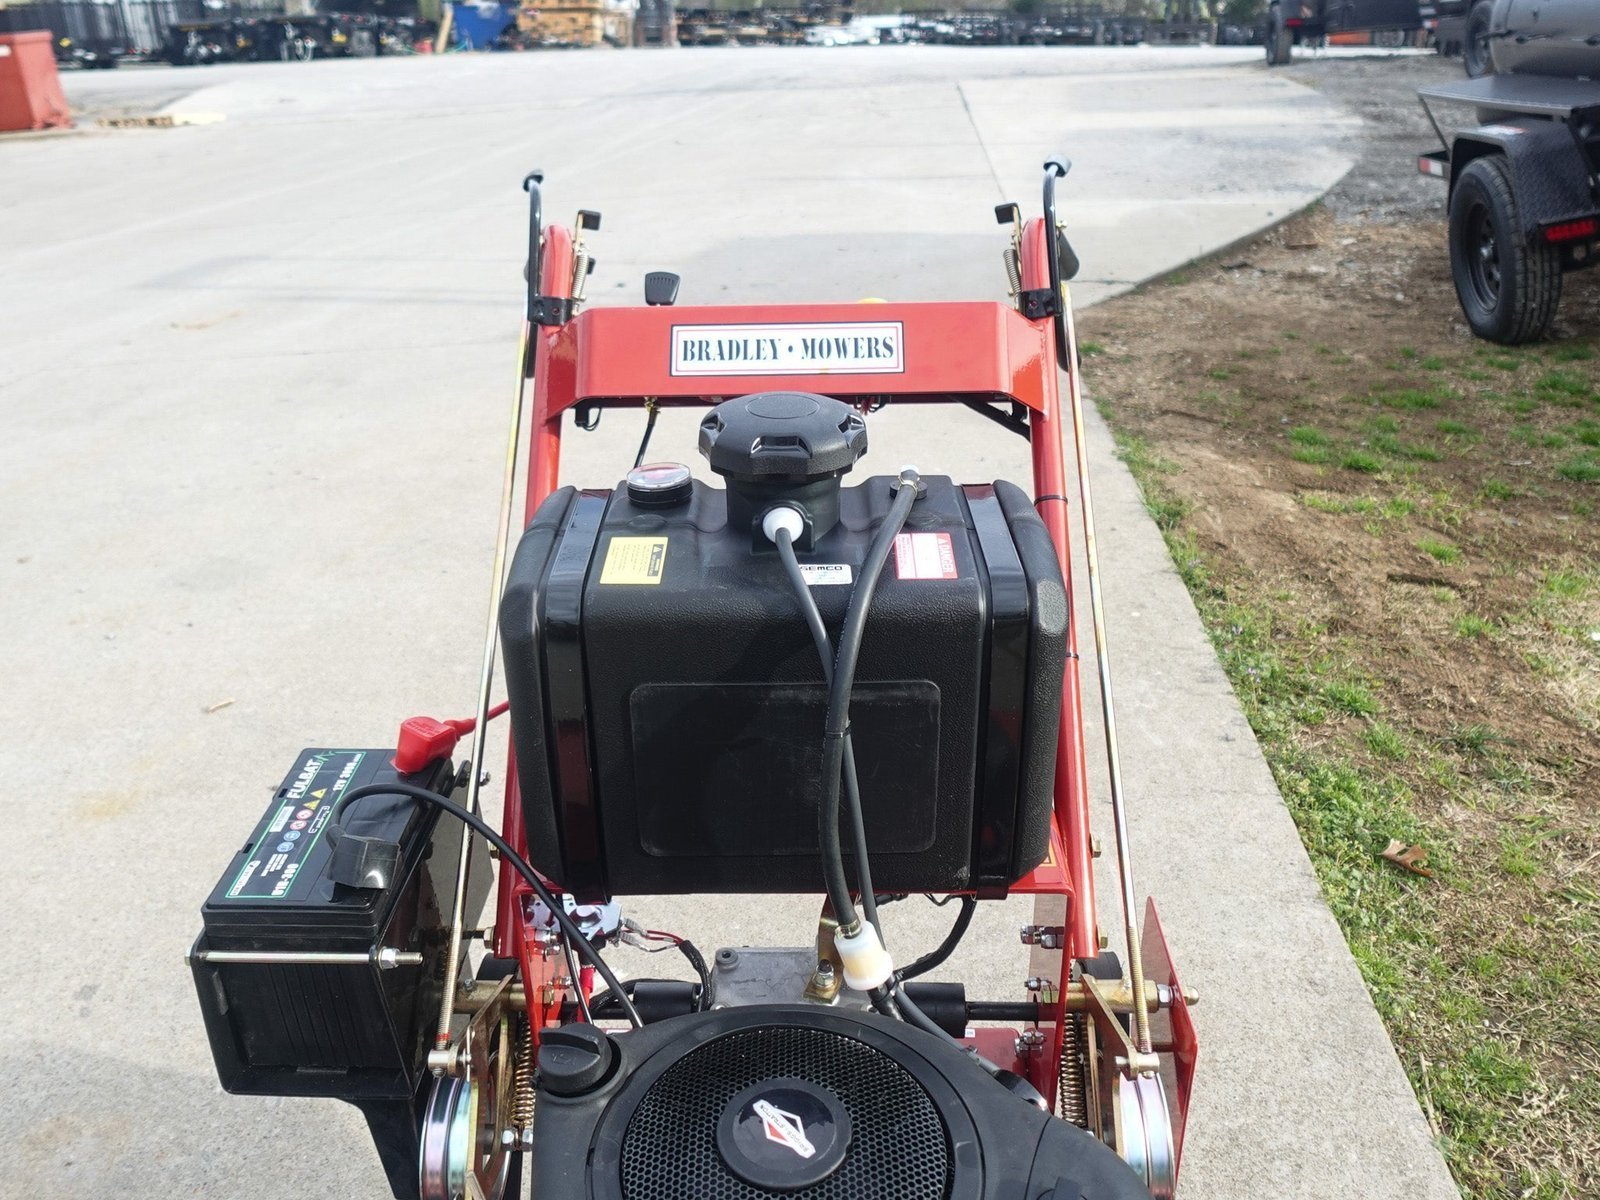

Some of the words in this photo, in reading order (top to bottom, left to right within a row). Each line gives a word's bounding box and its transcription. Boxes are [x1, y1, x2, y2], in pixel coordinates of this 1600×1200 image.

[682, 338, 782, 362] BRADLEY
[801, 336, 894, 360] MOWERS
[286, 758, 321, 799] FULBAT
[759, 1104, 786, 1130] STRATTON
